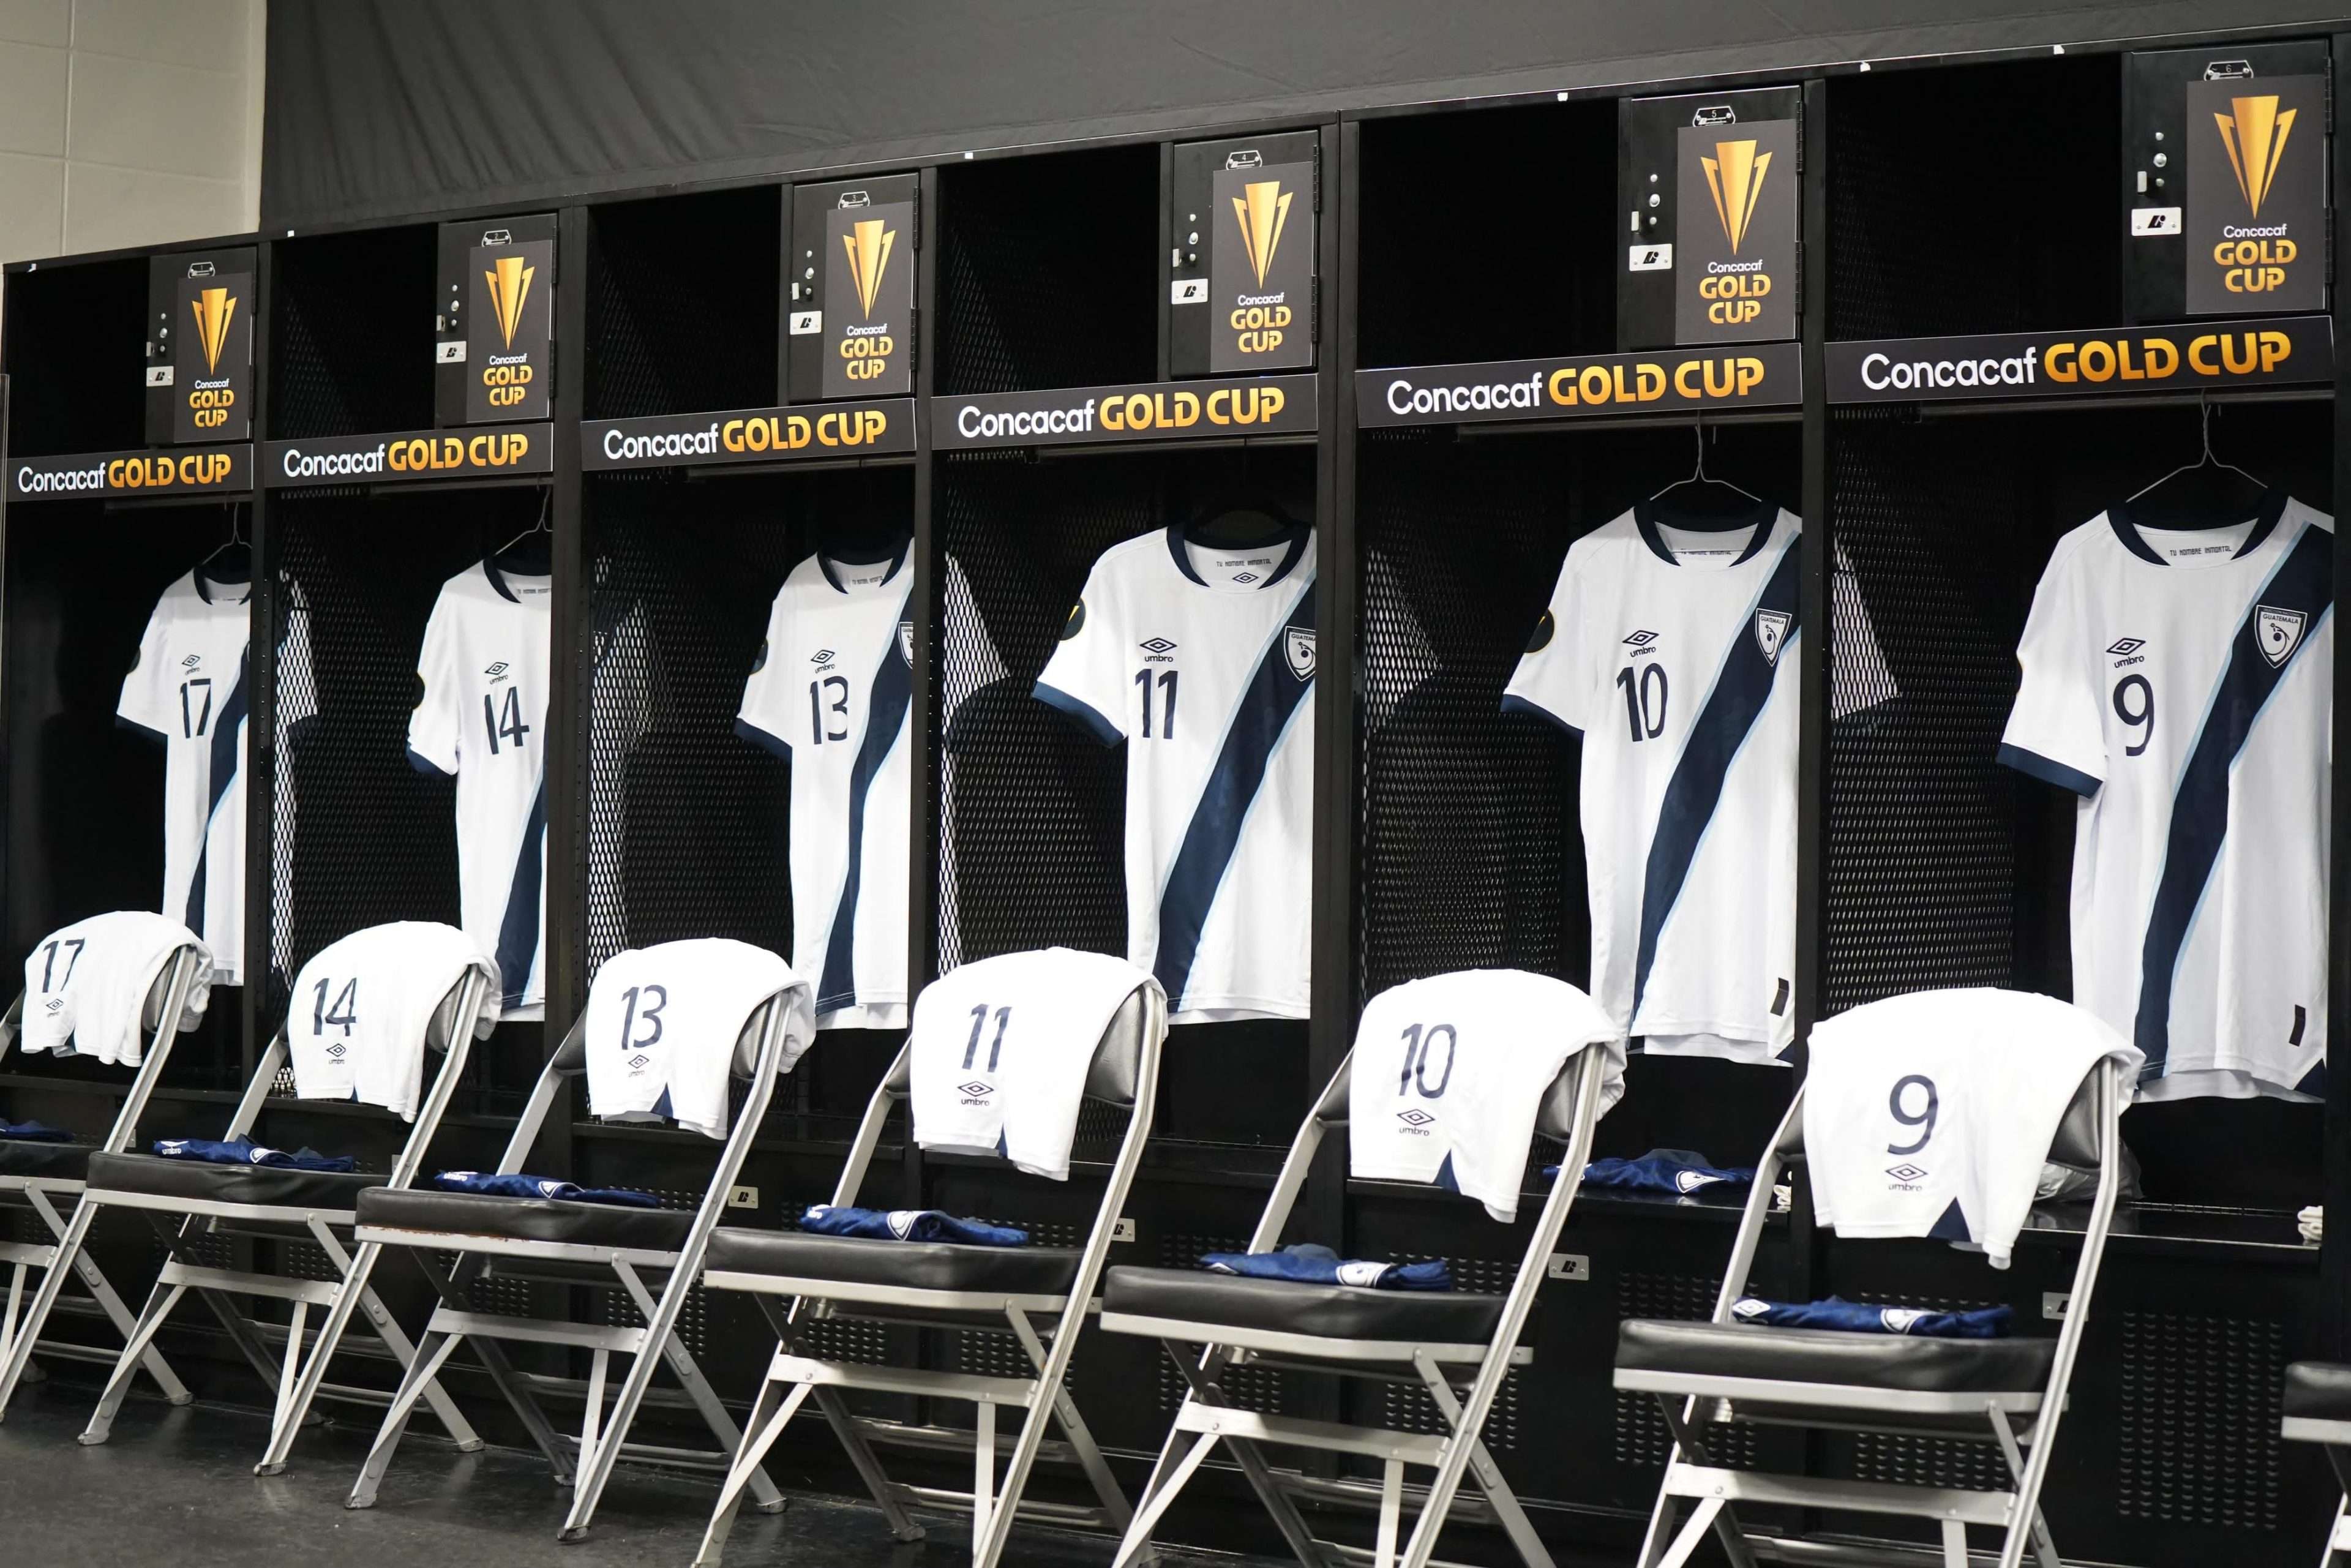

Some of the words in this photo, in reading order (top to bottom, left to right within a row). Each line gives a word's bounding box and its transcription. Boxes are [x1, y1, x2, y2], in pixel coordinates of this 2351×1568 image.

[2225, 64, 2232, 73] 6
[1711, 110, 1717, 118] 5
[2223, 223, 2288, 239] Concacaf
[2213, 240, 2298, 266] GOLD
[1708, 259, 1763, 274] Concacaf
[1699, 274, 1772, 300] GOLD
[2224, 267, 2286, 293] CUP
[1237, 292, 1285, 306] Concacaf
[1230, 306, 1292, 331] GOLD
[1707, 300, 1762, 325] CUP
[847, 323, 888, 337] Concacaf
[839, 337, 894, 358] GOLD
[1237, 331, 1284, 353] CUP
[489, 353, 528, 366] Concacaf
[846, 357, 887, 381] CUP
[1861, 347, 2037, 391] Concacaf
[2044, 338, 2180, 383] GOLD
[2188, 331, 2292, 375] CUP
[195, 378, 230, 389] Concacaf
[483, 366, 533, 386] GOLD
[1386, 372, 1543, 415] Concacaf
[1548, 363, 1667, 406] GOLD
[1674, 357, 1764, 399] CUP
[189, 389, 234, 408] GOLD
[489, 386, 527, 407] CUP
[195, 409, 228, 428] CUP
[958, 399, 1095, 439] Concacaf
[1099, 391, 1201, 432] GOLD
[1206, 386, 1285, 426] CUP
[604, 422, 719, 460] Concacaf
[722, 415, 812, 452] GOLD
[816, 410, 887, 446] CUP
[283, 443, 386, 478] Concacaf
[388, 437, 465, 471] GOLD
[468, 433, 529, 467] CUP
[18, 462, 106, 493] Concacaf
[108, 457, 176, 489] GOLD
[179, 454, 232, 485] CUP
[1760, 616, 1785, 625] GUATEMALA
[2263, 613, 2298, 625] GUATEMALA
[1144, 653, 1174, 662] umbro
[1630, 645, 1656, 658] umbro
[2113, 655, 2145, 669] umbro
[490, 674, 508, 685] umbro
[814, 663, 835, 674] umbro
[180, 678, 211, 738] 17
[809, 676, 848, 745] 13
[1135, 668, 1179, 740] 11
[1616, 662, 1668, 742] 10
[484, 686, 529, 754] 14
[2112, 673, 2154, 757] 9
[42, 937, 85, 993] 17
[313, 977, 357, 1037] 14
[621, 984, 667, 1050] 13
[962, 1003, 1013, 1073] 11
[1398, 1023, 1457, 1099] 10
[961, 1097, 990, 1106] umbro
[1887, 1074, 1938, 1155] 9
[1398, 1127, 1430, 1137] umbro
[1888, 1182, 1922, 1192] umbro
